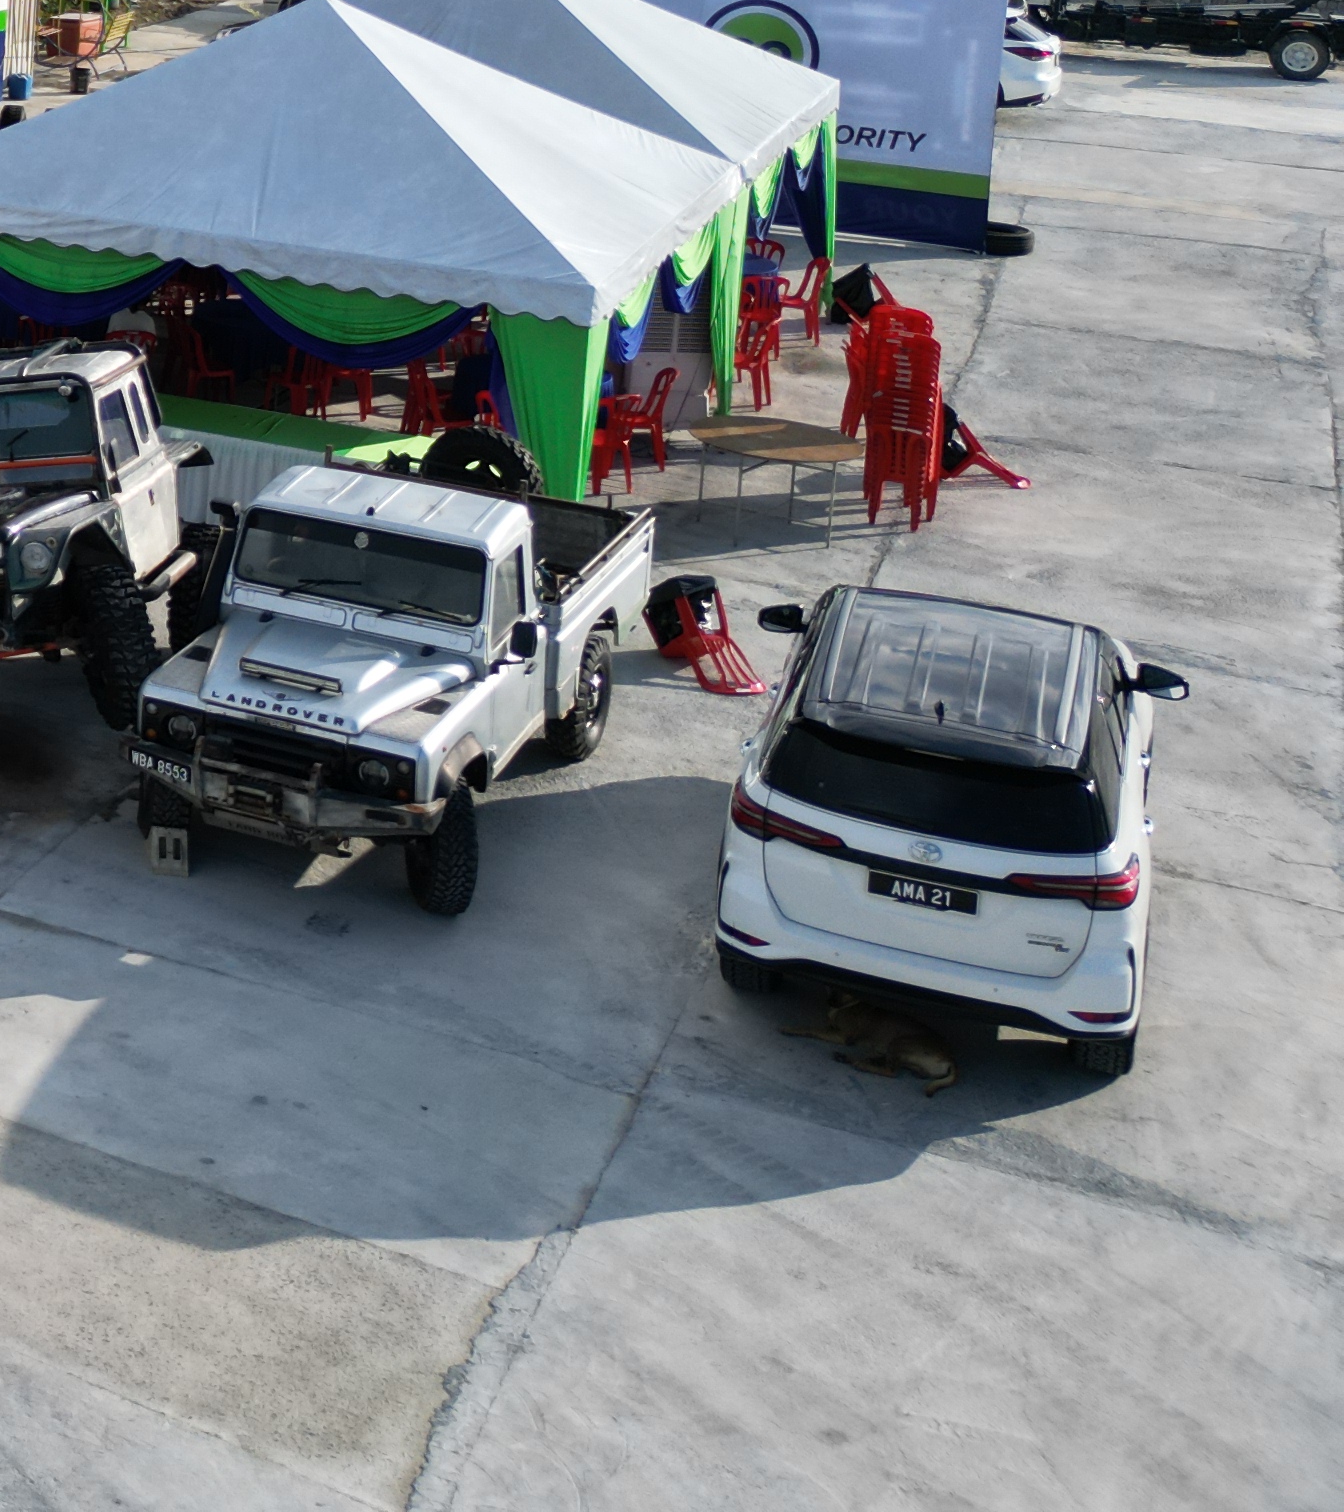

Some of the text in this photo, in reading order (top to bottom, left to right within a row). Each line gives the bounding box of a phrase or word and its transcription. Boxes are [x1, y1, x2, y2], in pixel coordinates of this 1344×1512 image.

[836, 125, 927, 152] ORITY
[131, 749, 188, 782] WBA 8553
[891, 880, 951, 907] AMA 21
